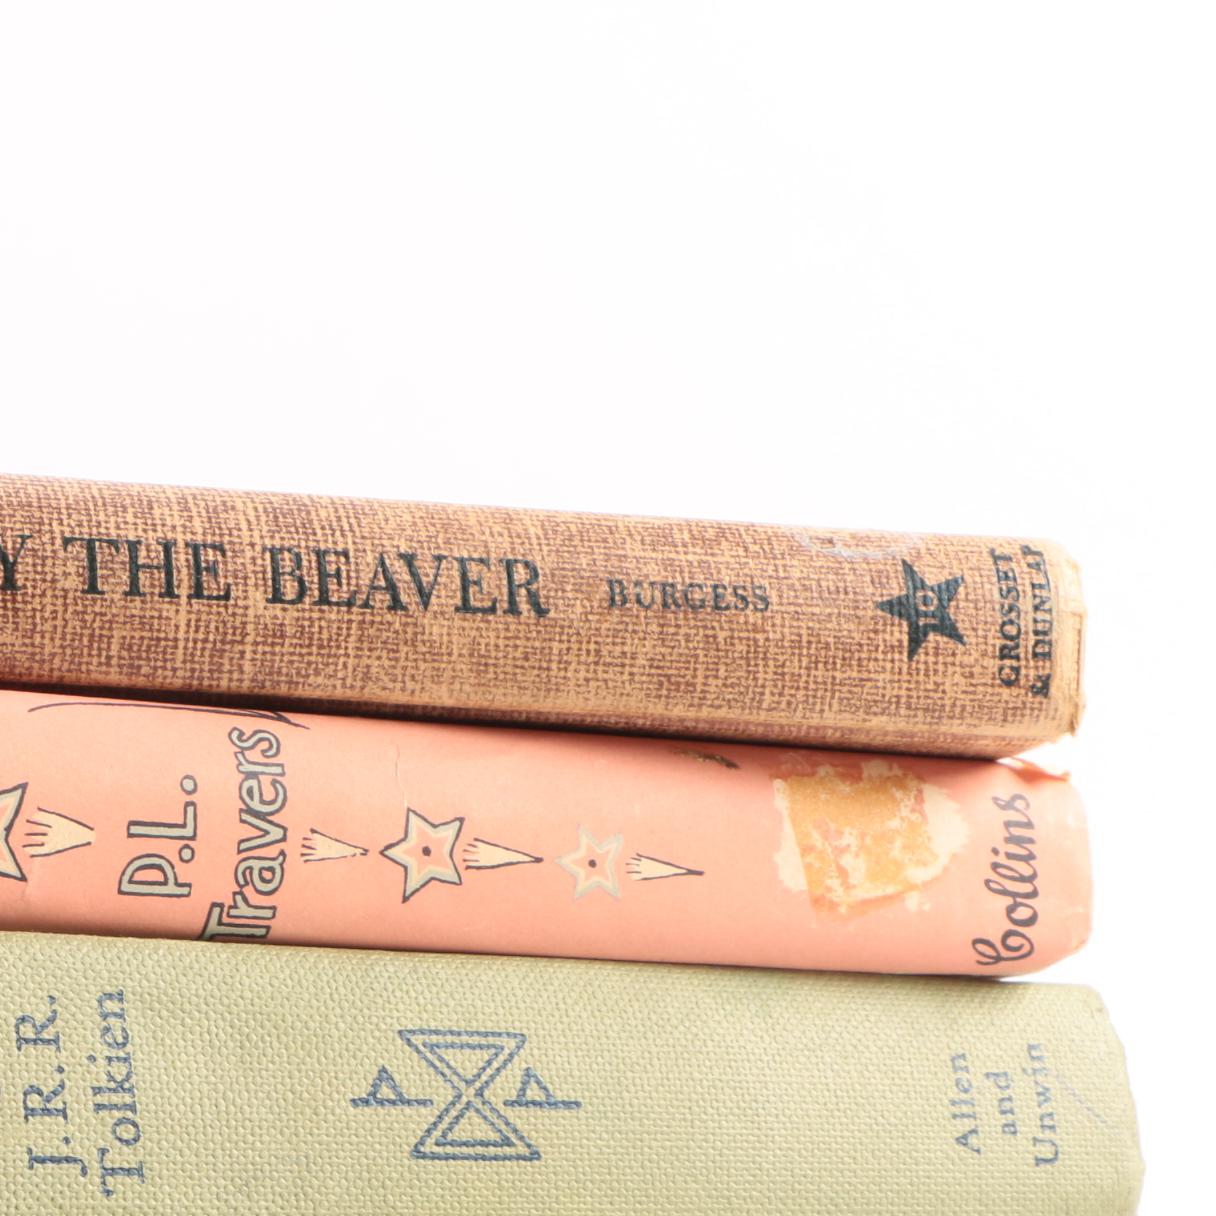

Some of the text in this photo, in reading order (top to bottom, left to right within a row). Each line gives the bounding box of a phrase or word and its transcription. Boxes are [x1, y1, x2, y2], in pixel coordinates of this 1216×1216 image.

[63, 535, 232, 601] THE
[263, 545, 551, 617] BEAVER
[607, 577, 771, 613] BURGESS
[989, 547, 1021, 687] GROSSET
[1020, 544, 1054, 660] DUNLAP
[117, 774, 198, 898] P.L.
[198, 726, 288, 940] Travers
[971, 792, 1040, 967] Collins
[87, 988, 146, 1198] Tolkien
[948, 1052, 982, 1156] Allen
[984, 1070, 1019, 1137] and
[1022, 1042, 1061, 1168] Unwin
